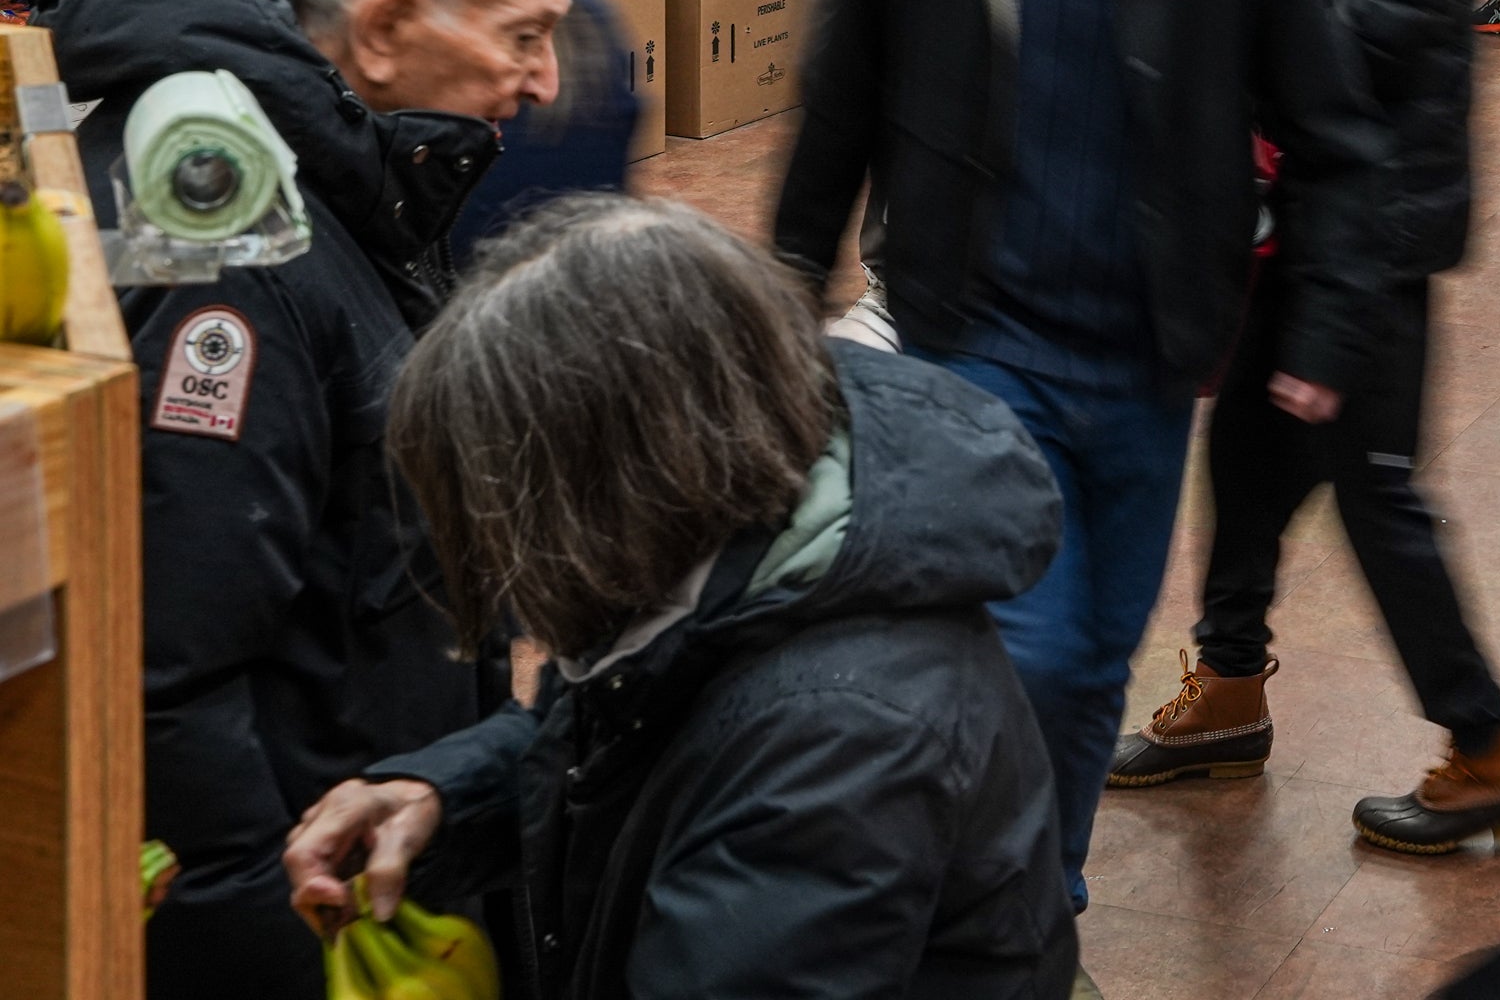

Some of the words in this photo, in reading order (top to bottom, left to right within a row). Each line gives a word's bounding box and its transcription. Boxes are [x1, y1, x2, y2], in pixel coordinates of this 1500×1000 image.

[757, 0, 786, 16] PERISHABLE
[753, 38, 766, 49] LIVE
[767, 31, 789, 44] PLANTS
[181, 375, 230, 400] OSC
